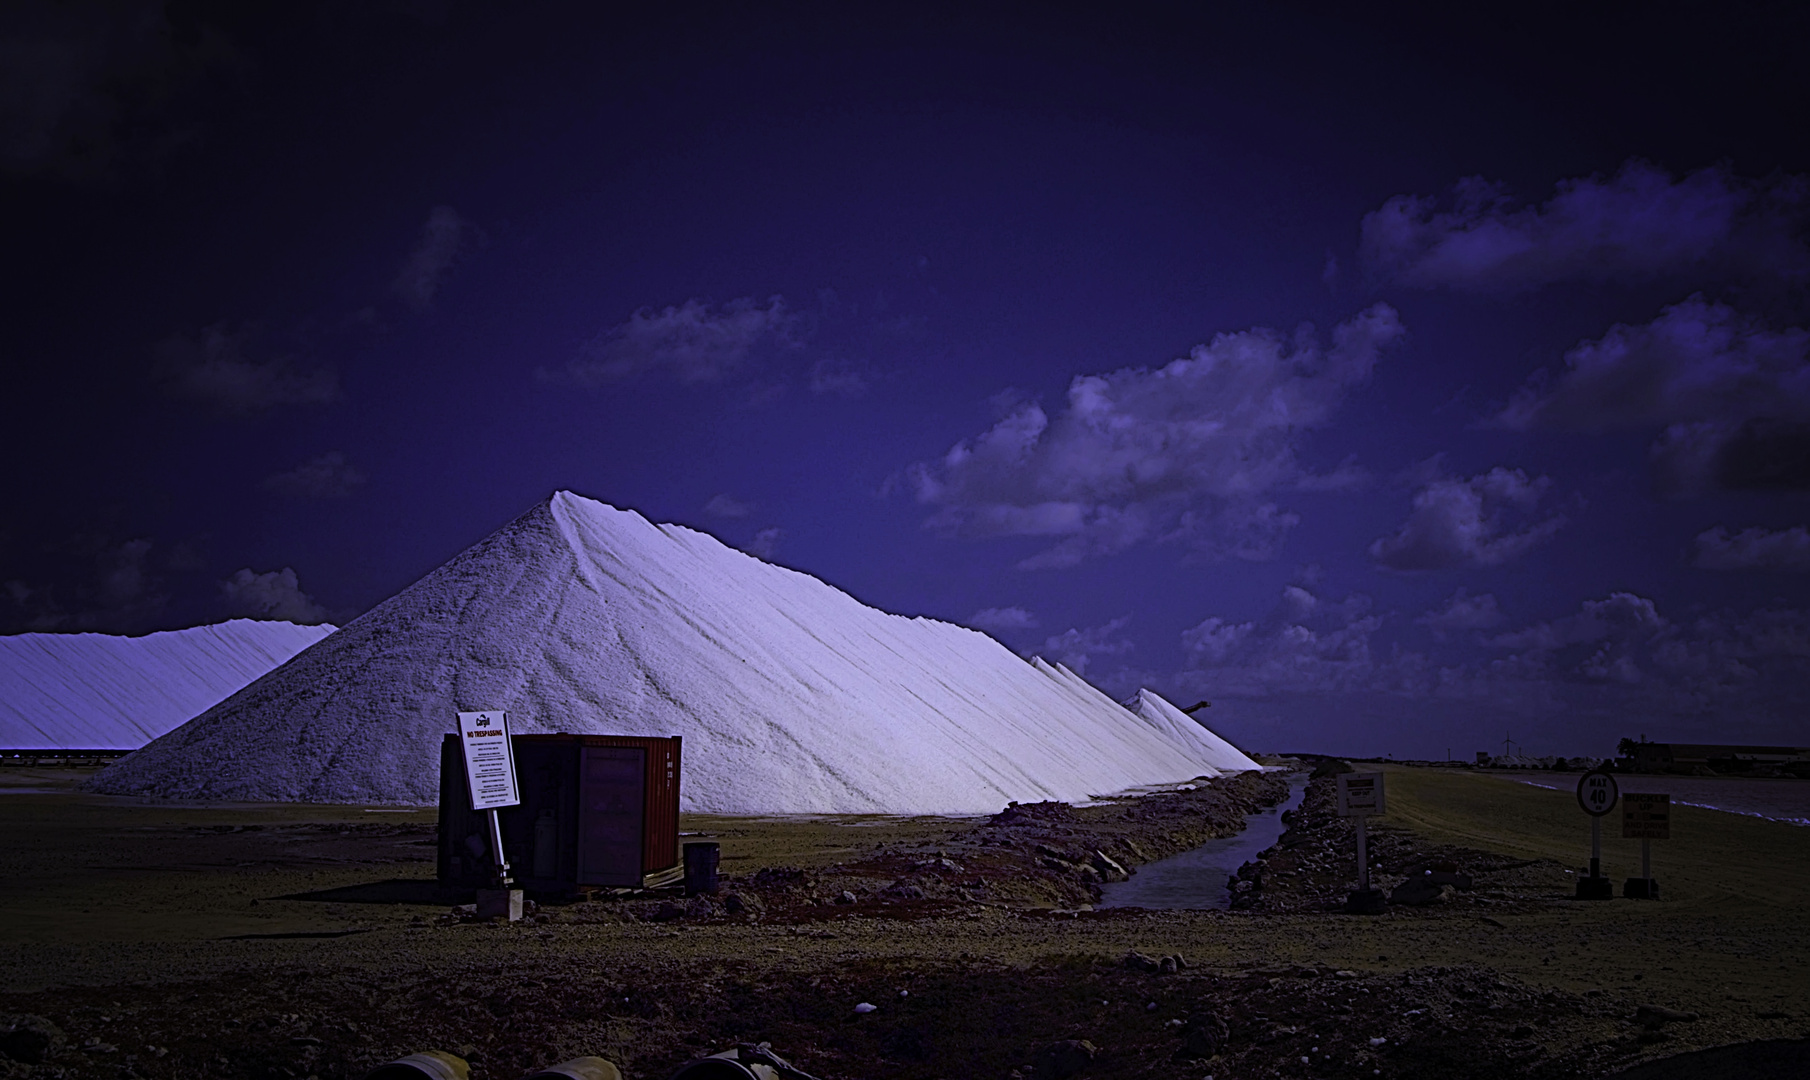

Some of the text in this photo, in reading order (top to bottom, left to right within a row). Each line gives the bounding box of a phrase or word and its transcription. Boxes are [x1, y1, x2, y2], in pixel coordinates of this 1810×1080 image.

[476, 717, 490, 728] Cargill
[1590, 778, 1606, 787] MAX
[1590, 789, 1606, 804] 40
[1624, 794, 1669, 802] BUCKLE
[1644, 822, 1668, 830] DRIVE
